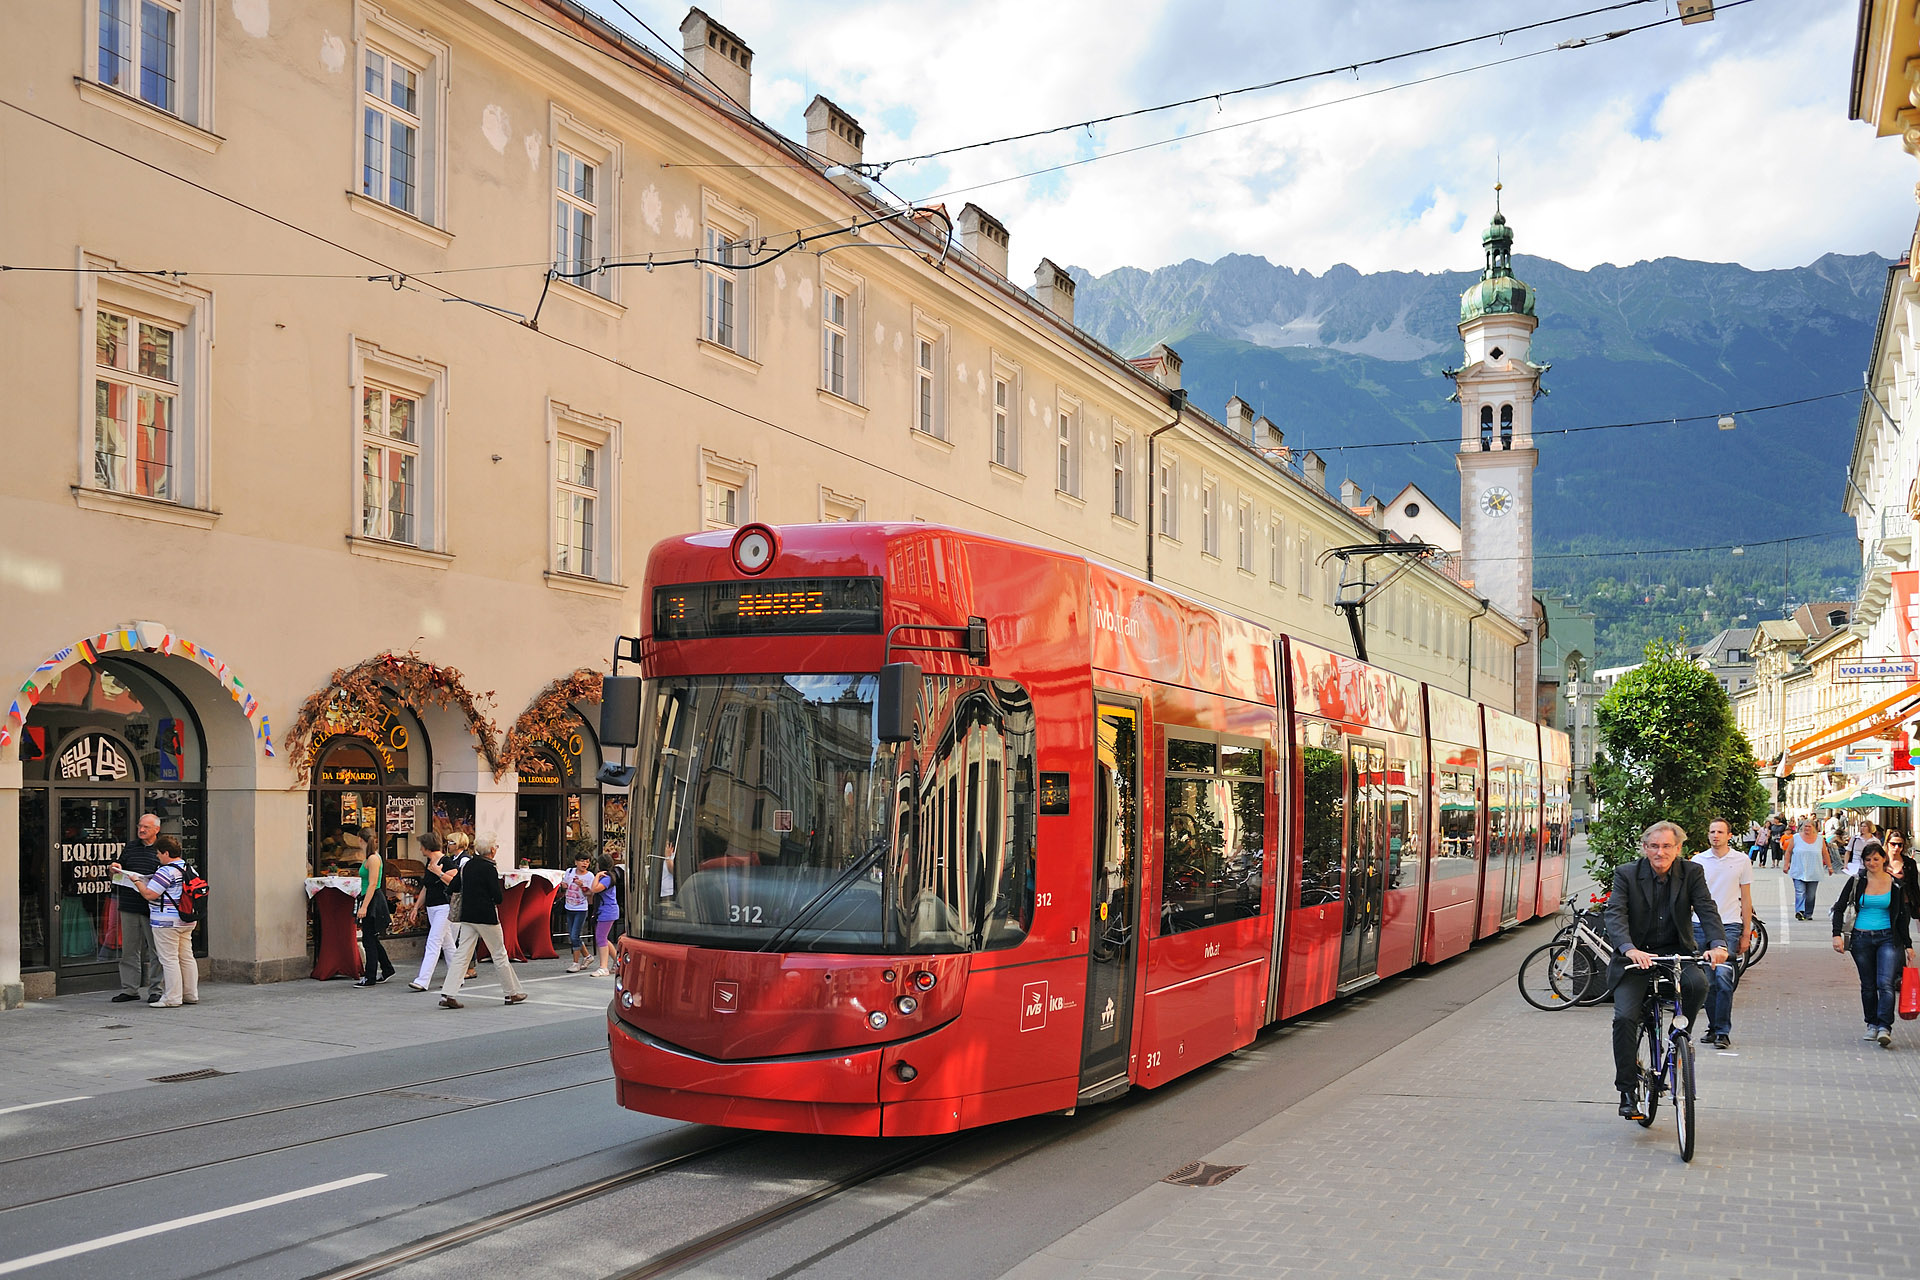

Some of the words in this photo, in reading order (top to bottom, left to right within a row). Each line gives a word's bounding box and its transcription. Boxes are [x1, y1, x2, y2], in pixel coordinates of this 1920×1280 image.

[1096, 600, 1140, 639] ivb.tram
[1841, 665, 1913, 675] VOLKSBANK
[60, 737, 90, 768] NEW
[546, 735, 574, 777] TALIANE
[62, 758, 92, 779] ERA
[162, 769, 177, 778] NBA
[322, 772, 333, 780] DA
[74, 865, 112, 879] SPOR
[77, 881, 112, 894] MODE
[1036, 893, 1052, 907] 312
[730, 904, 763, 924] 312
[1025, 1003, 1043, 1017] IVB
[1146, 1051, 1161, 1069] 312
